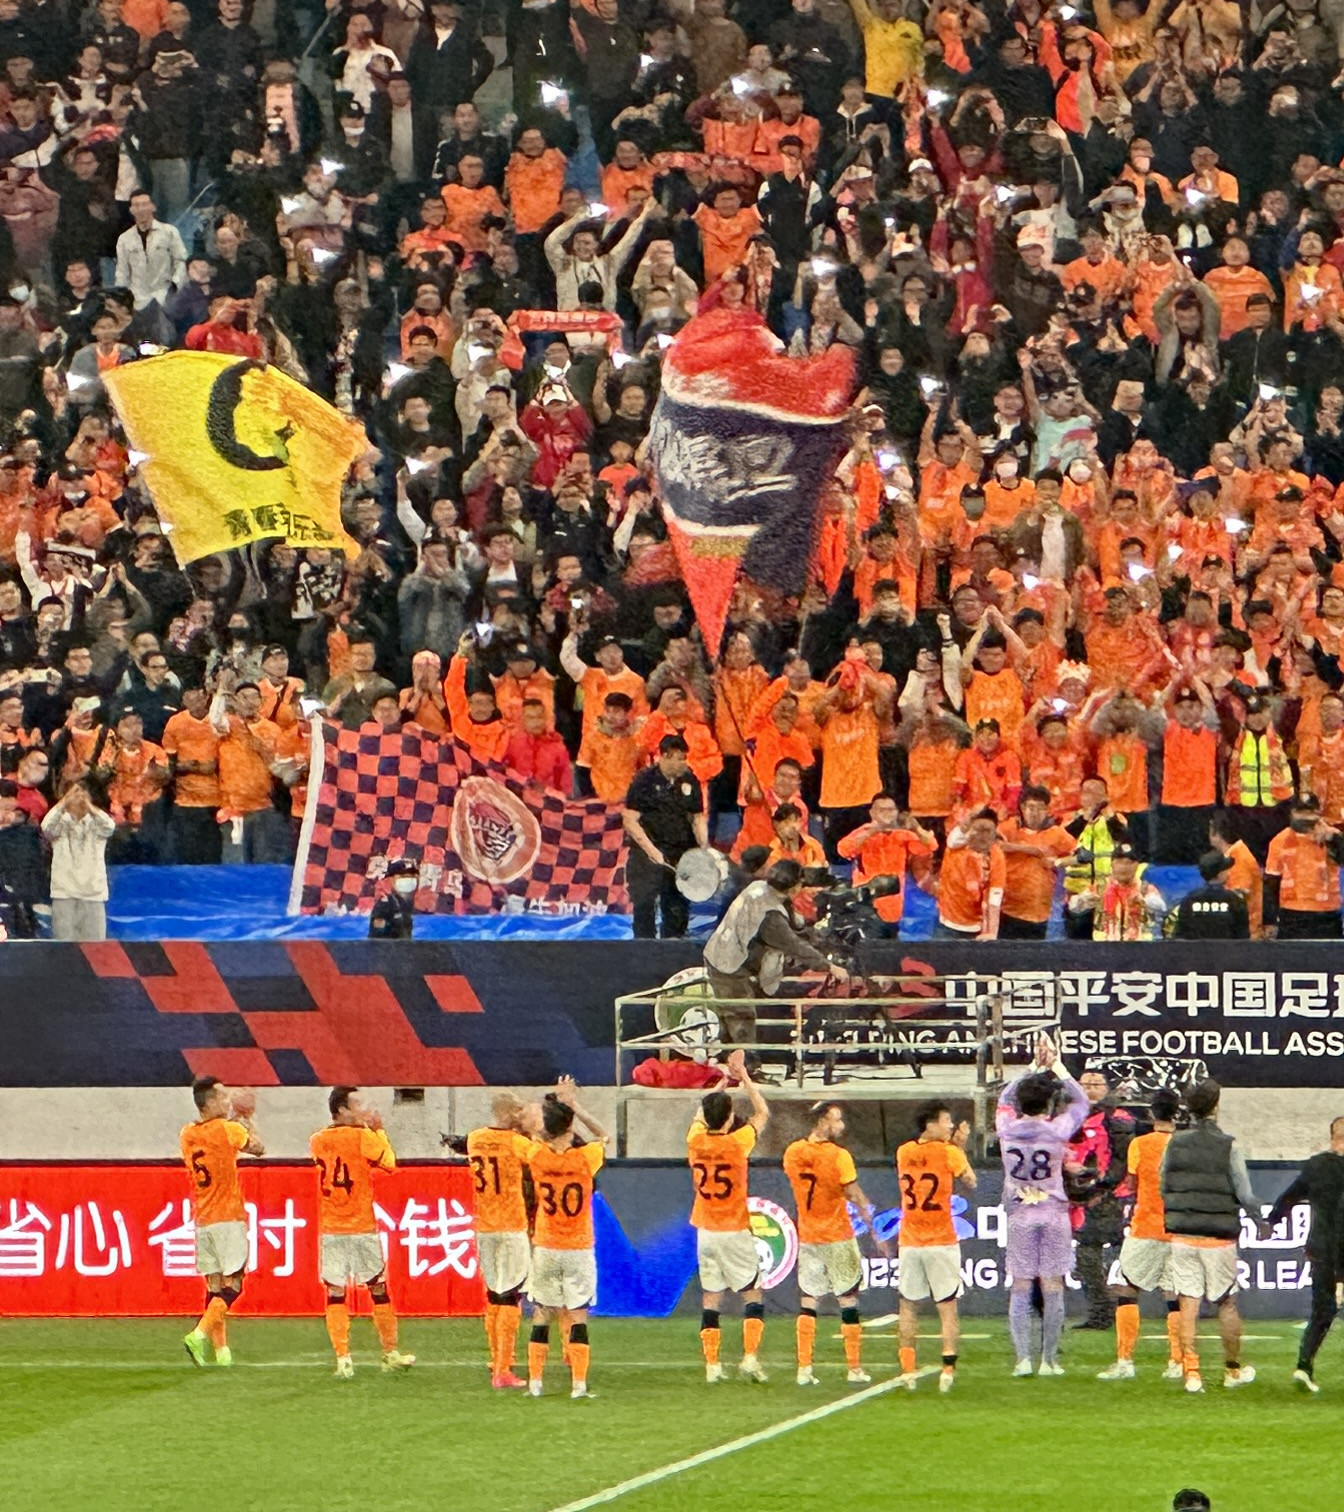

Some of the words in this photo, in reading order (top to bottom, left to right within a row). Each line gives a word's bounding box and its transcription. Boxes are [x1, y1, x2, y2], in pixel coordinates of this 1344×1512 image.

[1122, 1029, 1280, 1056] FOOTBALL
[469, 1155, 501, 1195] 31
[693, 1162, 734, 1200] 25
[1006, 1147, 1051, 1181] 28
[539, 1182, 584, 1218] 30
[798, 1172, 818, 1211] 7
[900, 1172, 943, 1212] 32
[0, 1199, 133, 1277] 省心
